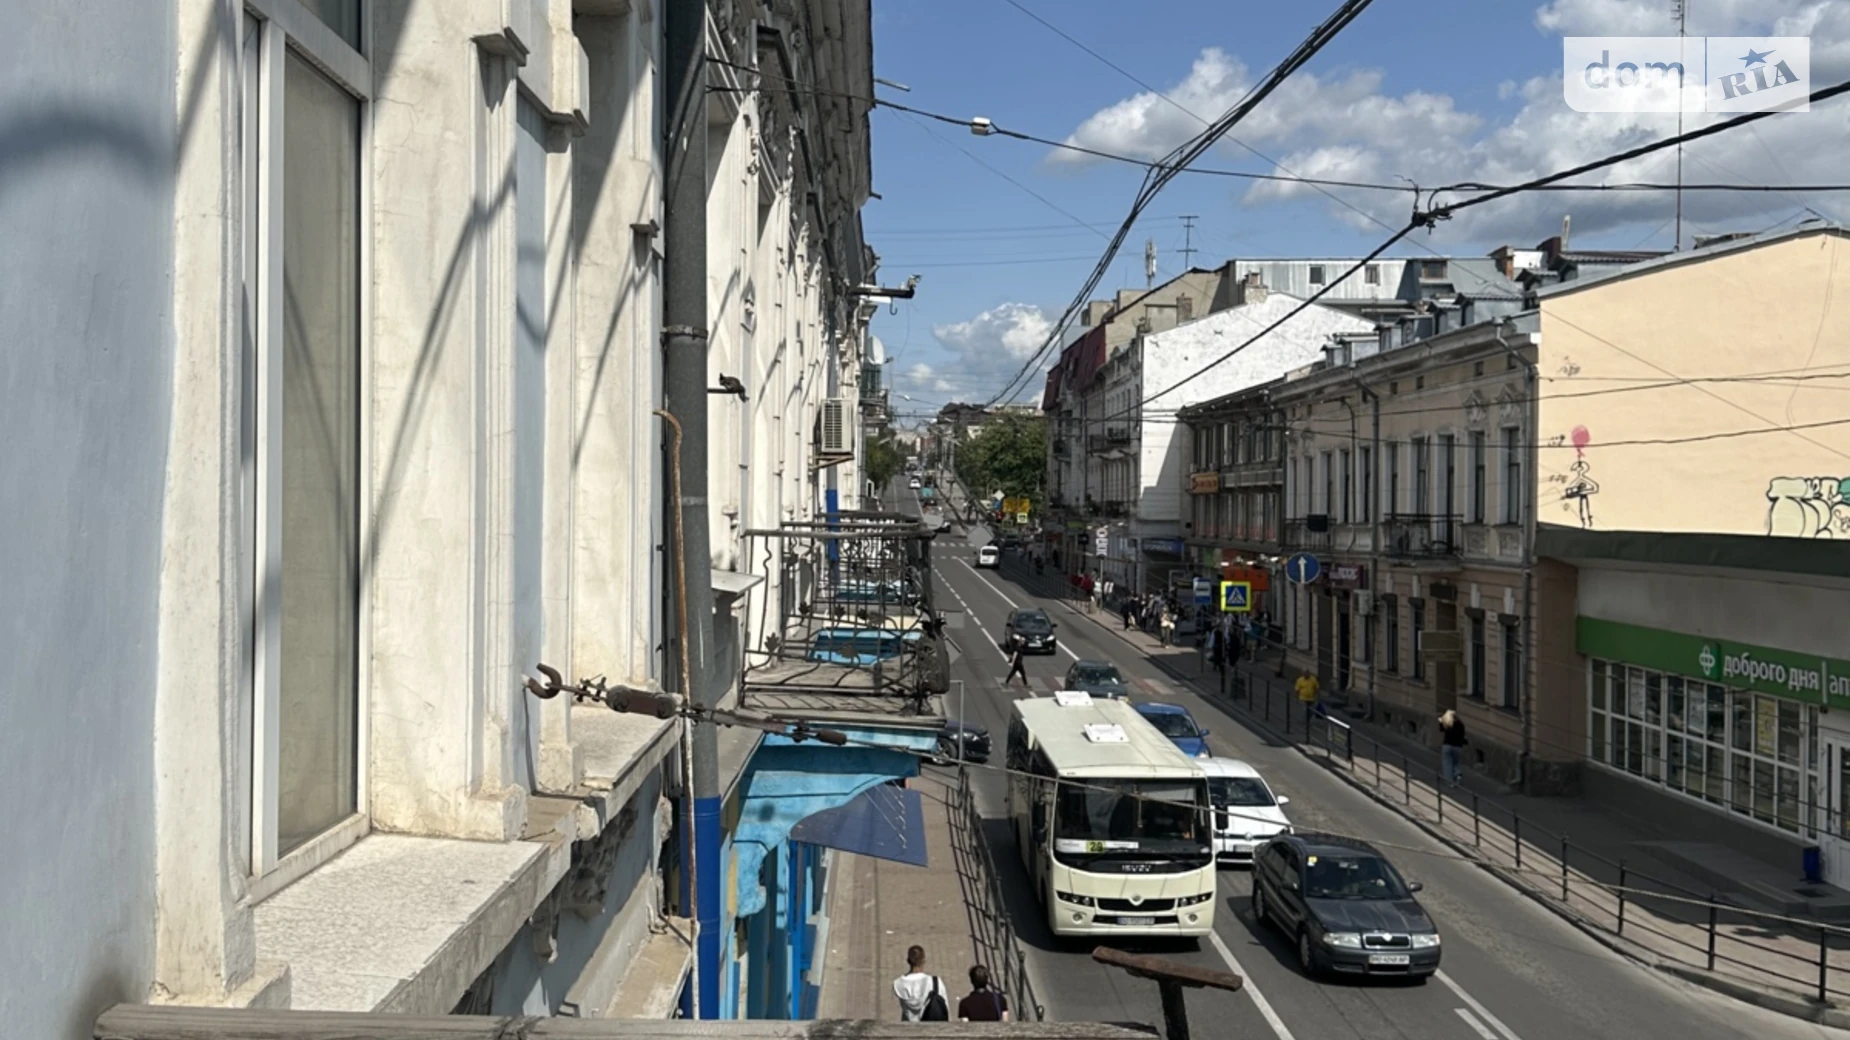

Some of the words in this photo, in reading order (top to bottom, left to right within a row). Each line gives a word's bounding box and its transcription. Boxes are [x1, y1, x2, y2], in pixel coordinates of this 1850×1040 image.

[1723, 652, 1787, 684] доброго
[1788, 667, 1819, 692] дня
[1122, 864, 1152, 872] ISUZU
